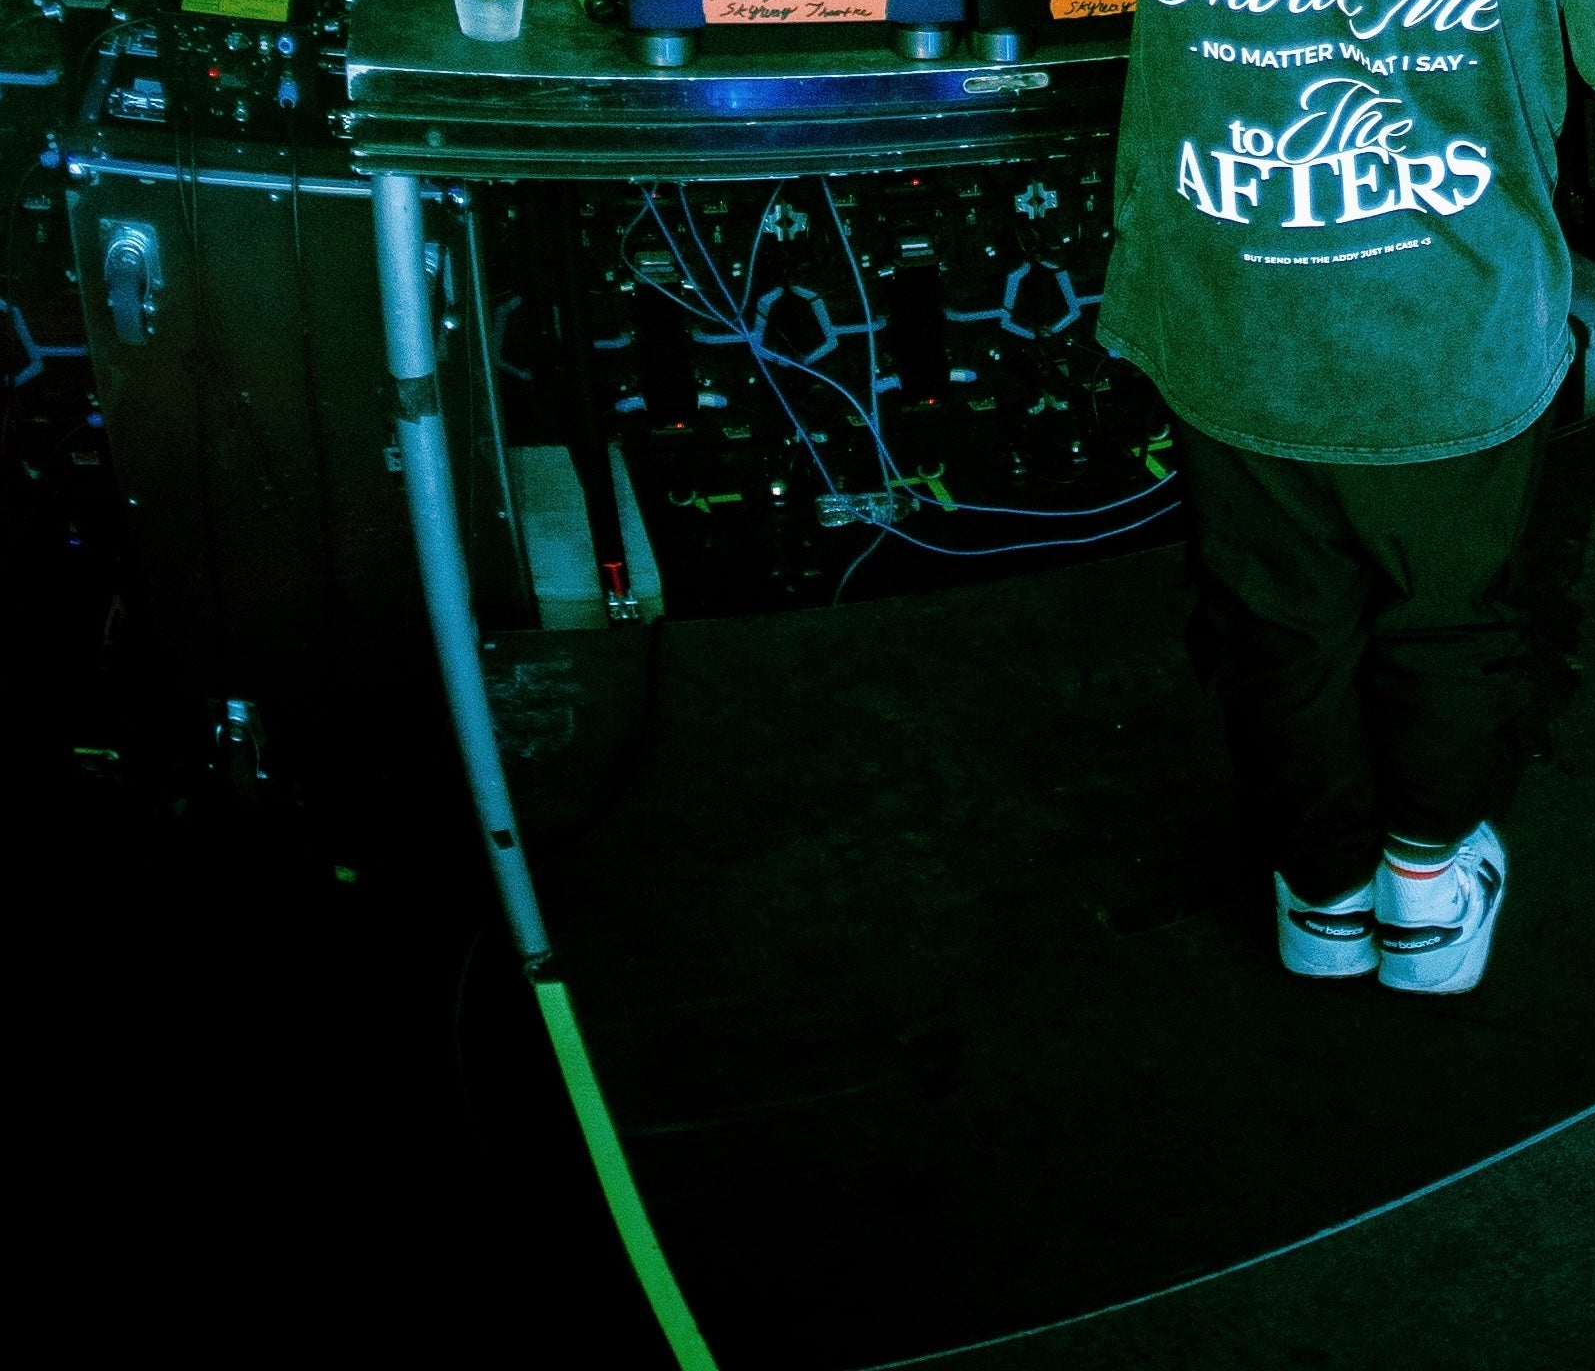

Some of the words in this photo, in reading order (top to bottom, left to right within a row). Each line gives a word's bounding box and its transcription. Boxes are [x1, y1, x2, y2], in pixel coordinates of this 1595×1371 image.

[1203, 41, 1236, 62] NO
[1241, 43, 1333, 69] MATTER
[1338, 42, 1398, 76] WHAT
[1402, 55, 1409, 71] I
[1415, 54, 1464, 72] SAY
[1230, 119, 1273, 156] to
[1277, 76, 1413, 164] The
[1176, 139, 1493, 229] AFTERS
[1243, 253, 1262, 263] BUT
[1264, 256, 1292, 265] SEND
[1293, 257, 1309, 265] ME
[1311, 256, 1330, 264] THE
[1332, 252, 1358, 263] ADDY
[1360, 248, 1383, 259] JUST
[1384, 245, 1395, 254] IN
[1395, 239, 1419, 252] CASE
[1305, 920, 1325, 932] new
[1399, 936, 1441, 949] balance
